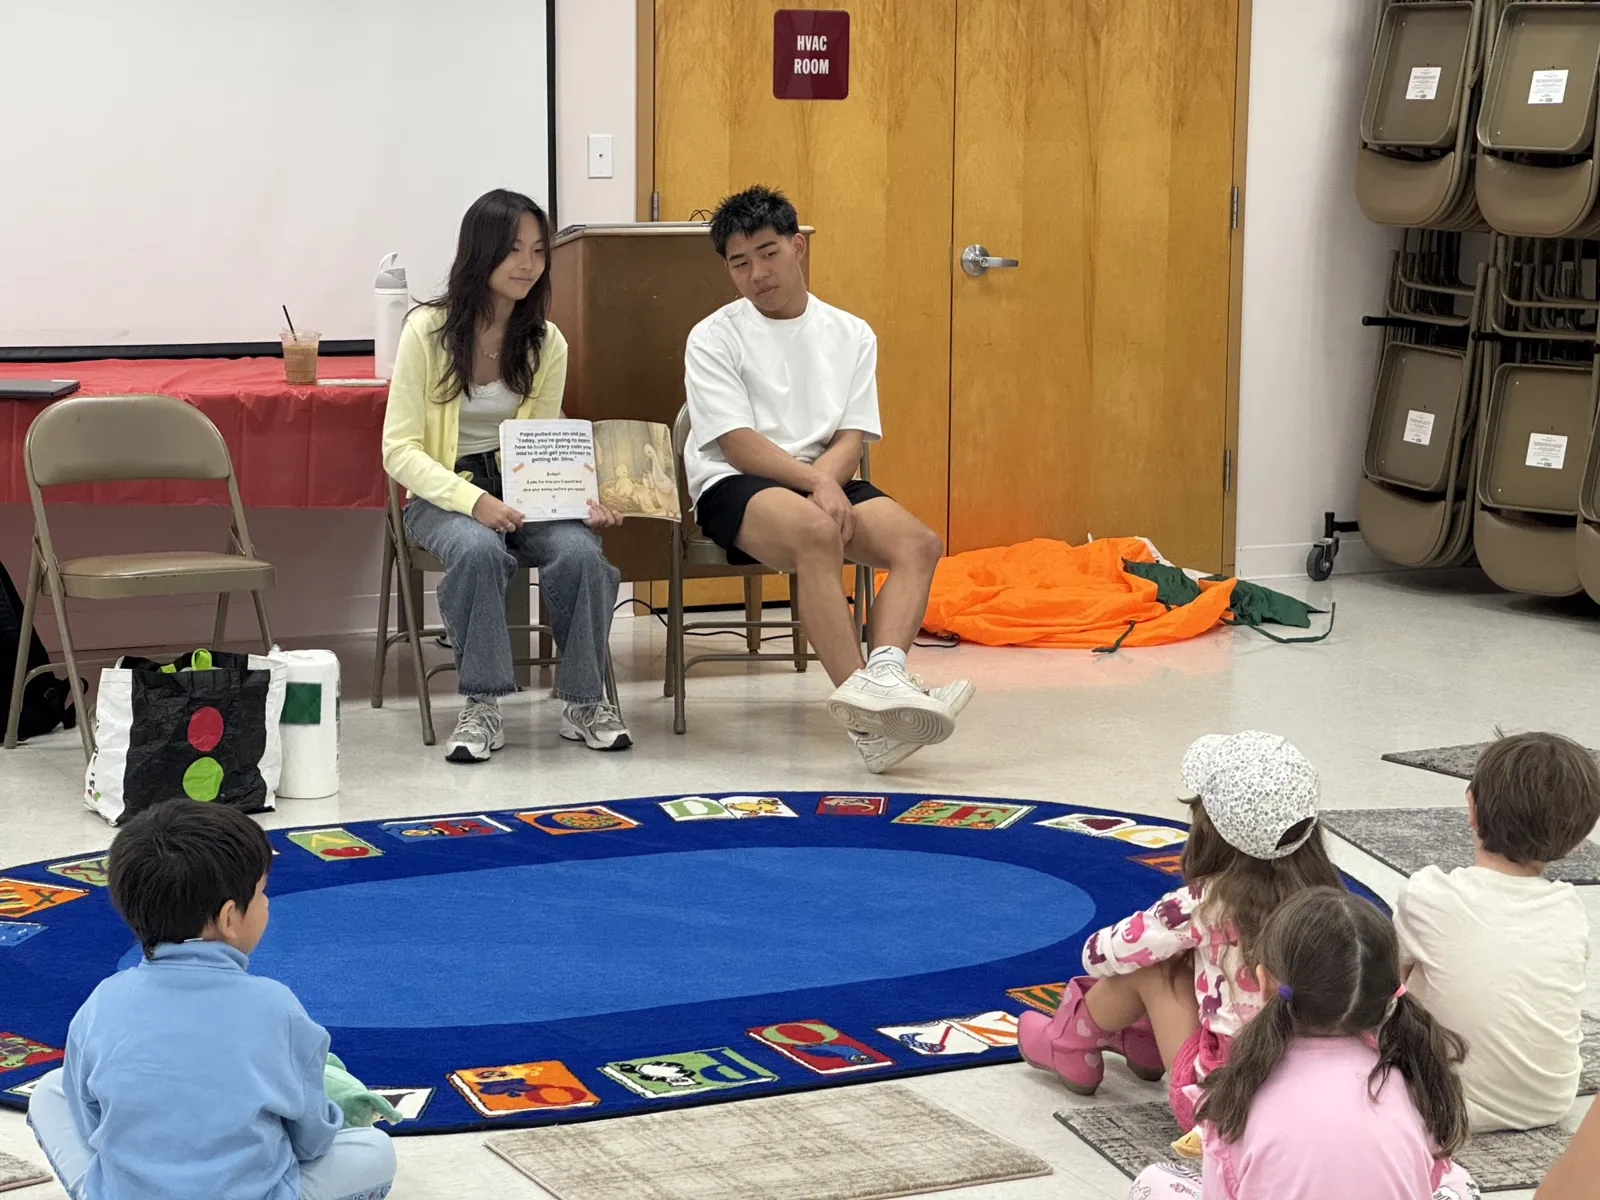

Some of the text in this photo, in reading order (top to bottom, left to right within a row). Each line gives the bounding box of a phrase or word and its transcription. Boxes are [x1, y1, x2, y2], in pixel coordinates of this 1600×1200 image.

[797, 35, 827, 51] HVAC
[794, 59, 829, 74] ROOM
[663, 800, 726, 818] D
[940, 806, 1009, 821] F
[1113, 827, 1188, 845] G
[28, 887, 63, 907] X
[762, 1022, 839, 1045] O
